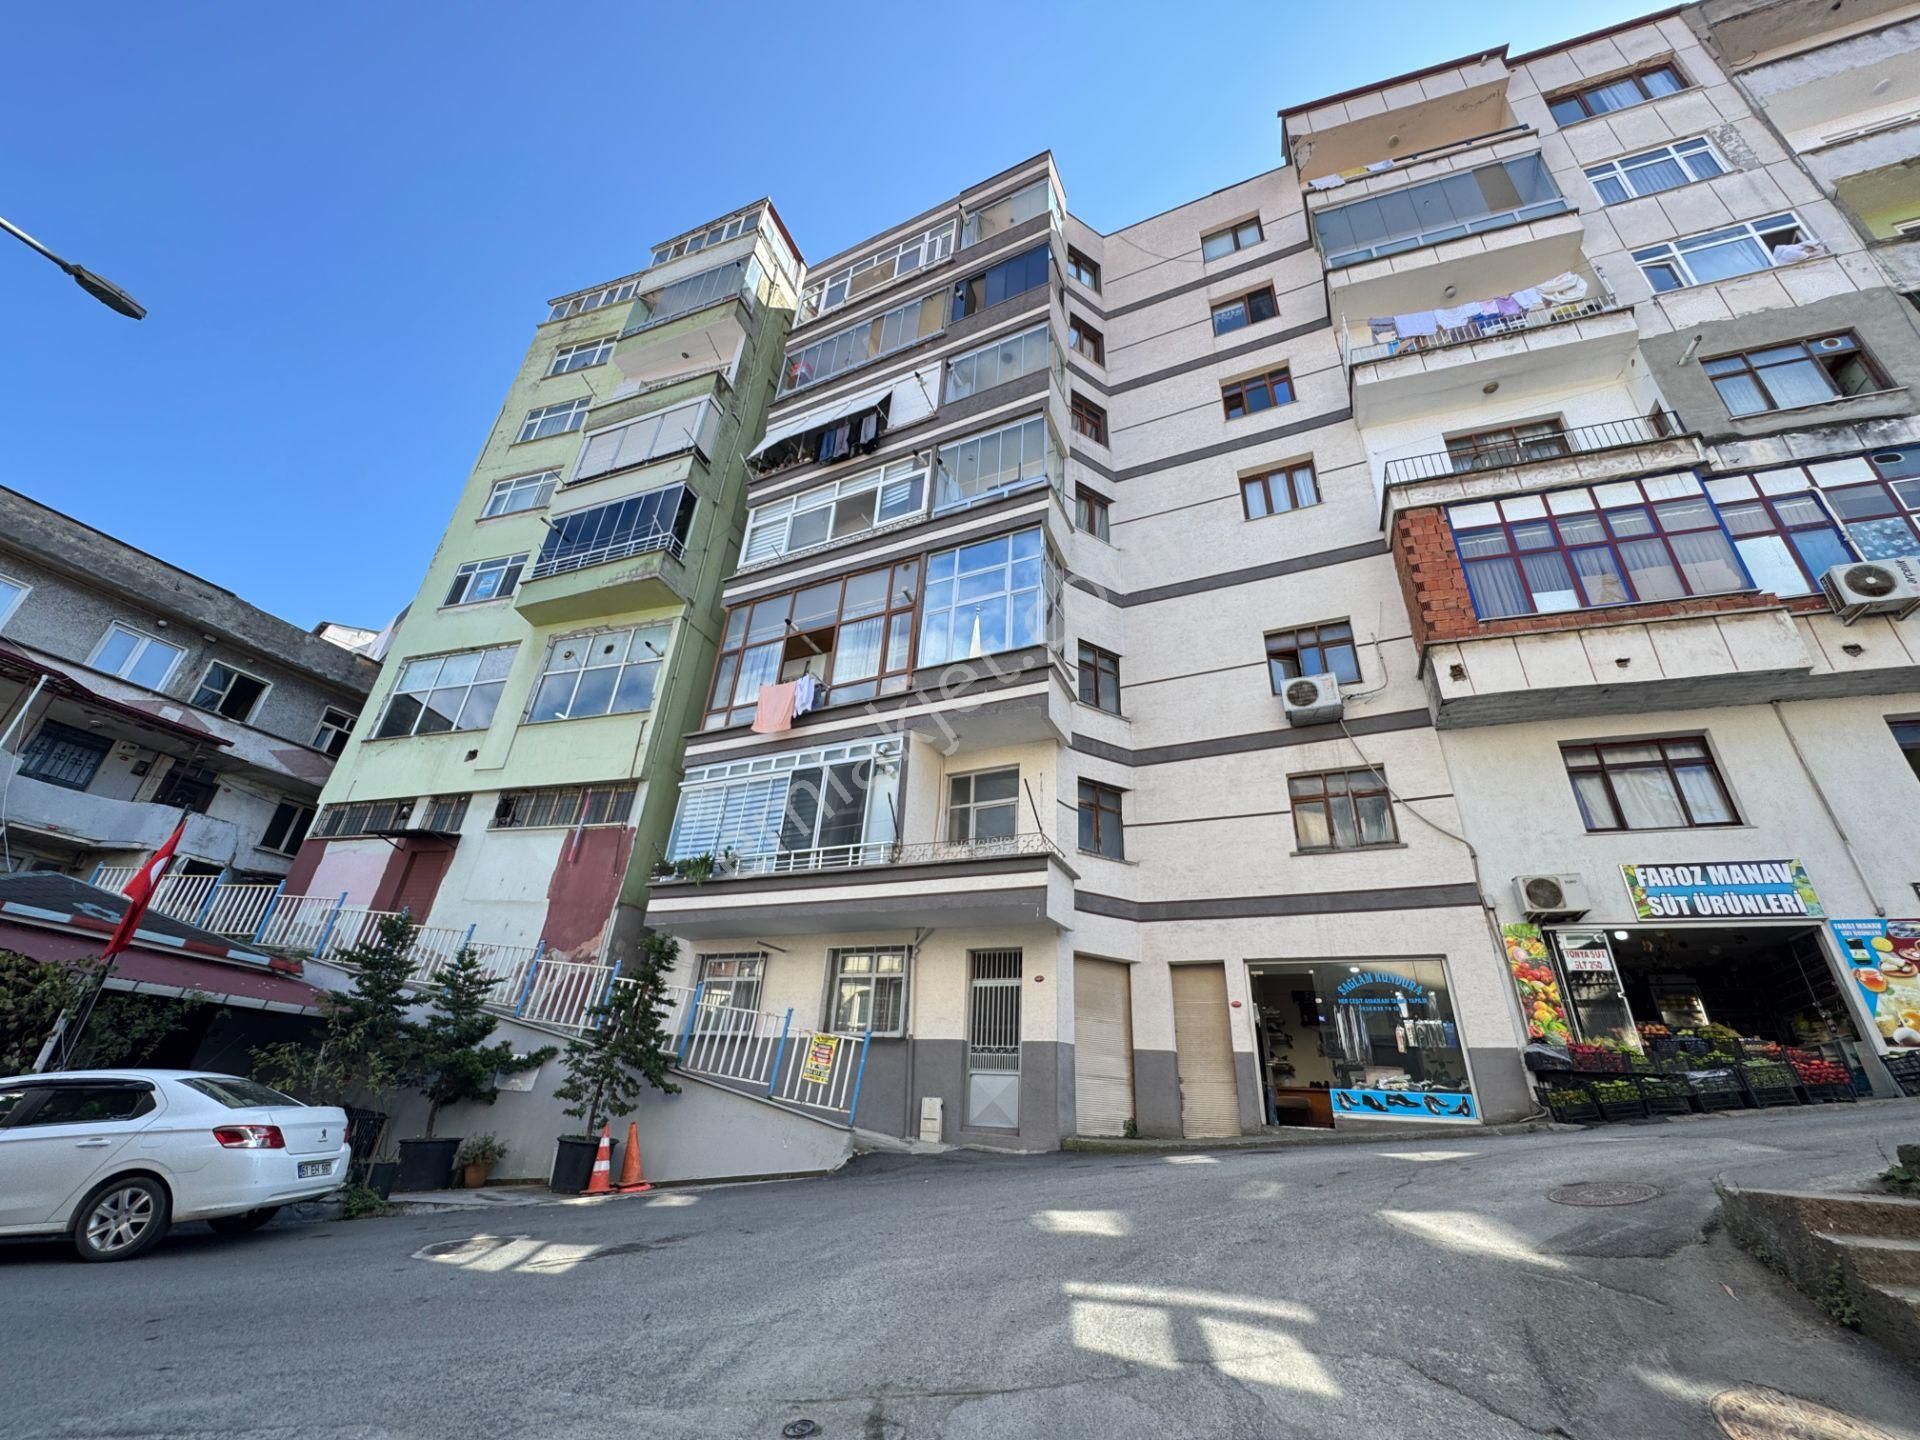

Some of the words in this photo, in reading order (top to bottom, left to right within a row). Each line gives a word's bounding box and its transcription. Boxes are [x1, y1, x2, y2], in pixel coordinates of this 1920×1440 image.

[1635, 866, 1706, 887] FAROZ
[1706, 863, 1793, 885] MANAV
[1647, 893, 1691, 916] SÜT
[1693, 890, 1808, 915] ÜRÜNLERİ
[1374, 972, 1423, 996] KUNDURA
